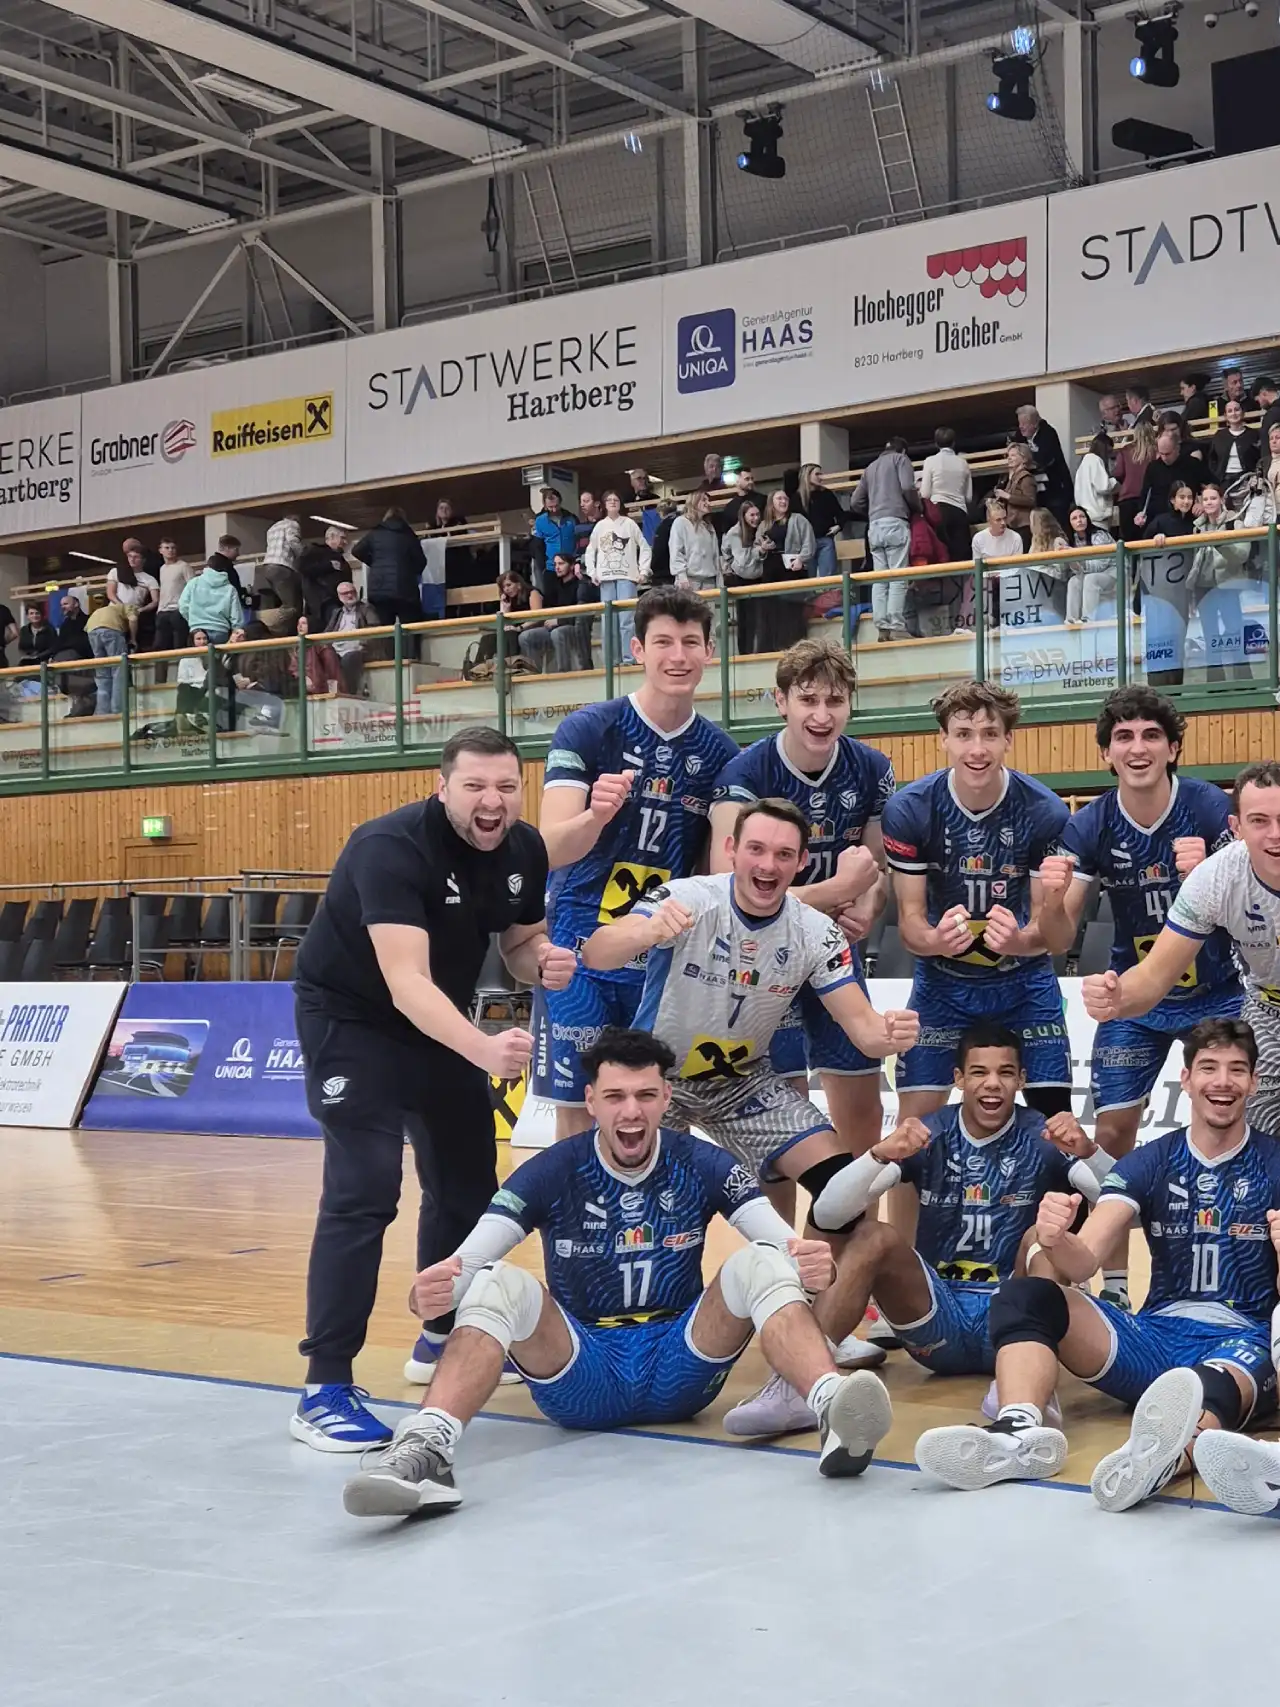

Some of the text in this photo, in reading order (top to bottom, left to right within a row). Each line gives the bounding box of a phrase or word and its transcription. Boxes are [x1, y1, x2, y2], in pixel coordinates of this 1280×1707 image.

[742, 305, 813, 328] GeneralAgentur
[853, 286, 944, 328] Hochegger
[742, 319, 813, 353] HAAS
[936, 316, 1000, 354] Dächer
[1000, 332, 1023, 344] GmbH
[369, 326, 637, 414] STADTWERKE
[678, 357, 729, 380] UNIQA
[854, 346, 924, 368] 8230 Hartberg
[507, 379, 638, 422] Hartberg
[91, 432, 159, 466] Grabner
[213, 421, 304, 453] Raiffeisen
[1063, 677, 1116, 688] Hartberg
[364, 733, 397, 743] Hartber
[637, 807, 668, 853] 12
[964, 879, 987, 913] 11
[0, 1004, 70, 1043] PARTNER
[728, 992, 746, 1029] 7
[552, 1023, 606, 1041] ÖKOPA
[10, 1049, 54, 1067] GMBH
[215, 1065, 253, 1078] UNIQA
[266, 1049, 304, 1067] HAA
[1169, 1202, 1188, 1210] nine
[583, 1221, 607, 1230] nine
[956, 1214, 993, 1252] 24
[573, 1244, 604, 1254] HAAS
[1190, 1243, 1220, 1292] 10
[618, 1260, 652, 1309] 17
[1233, 1348, 1257, 1365] 10
